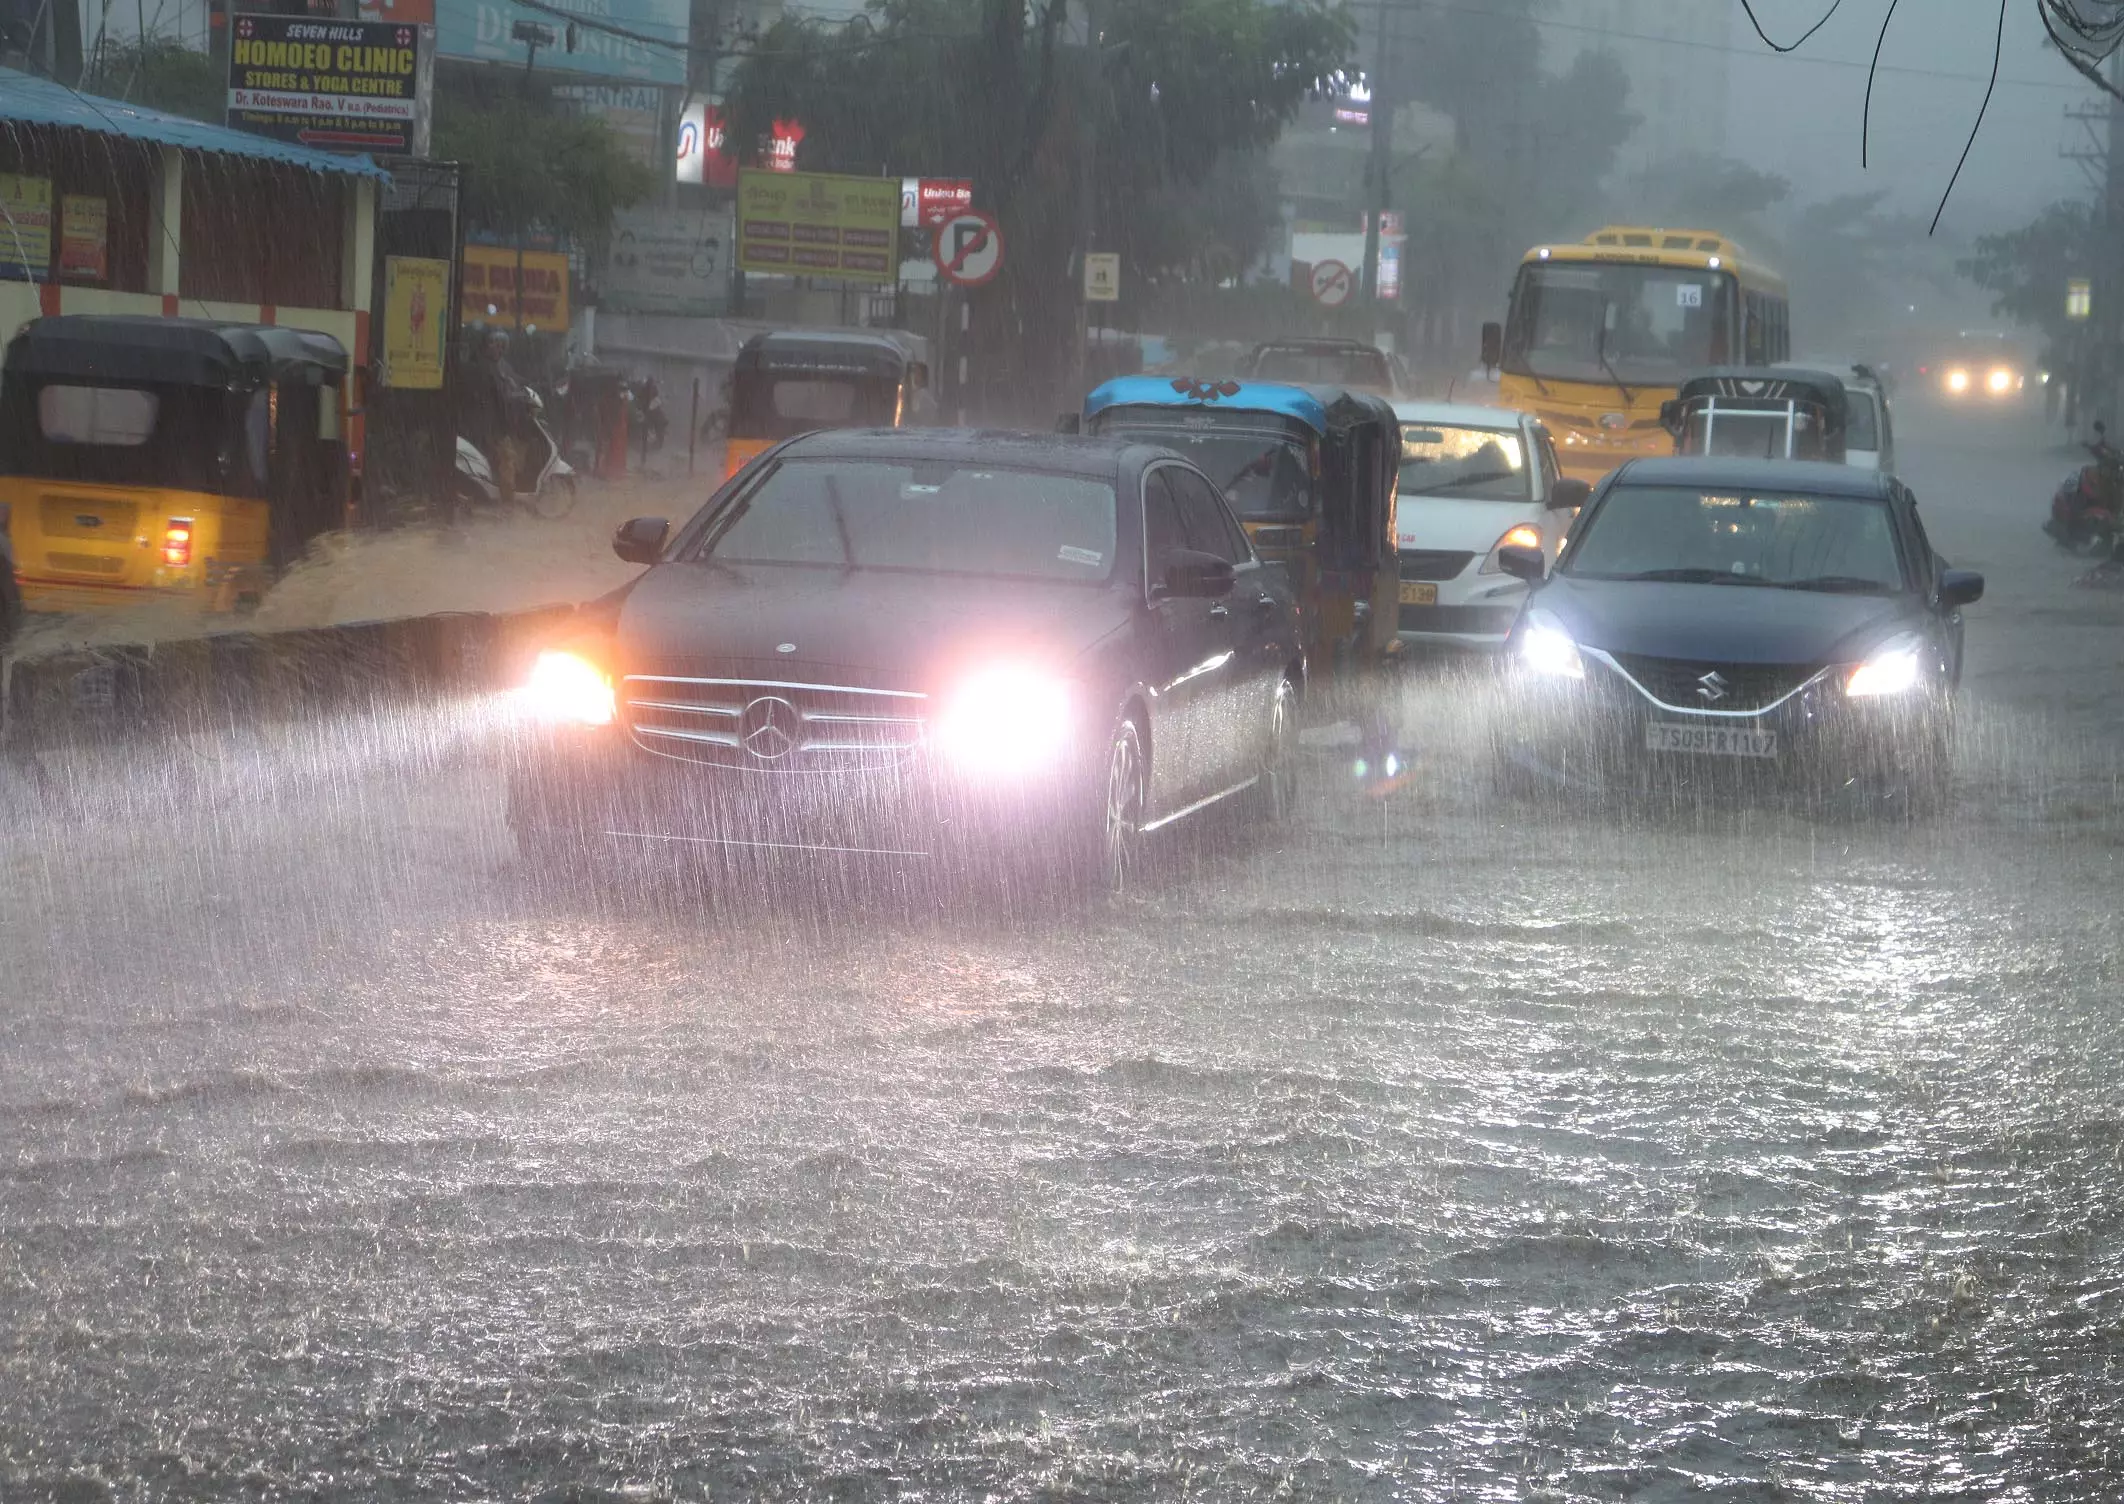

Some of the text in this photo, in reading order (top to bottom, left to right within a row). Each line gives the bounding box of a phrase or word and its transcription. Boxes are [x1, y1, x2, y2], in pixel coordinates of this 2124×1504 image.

[287, 24, 364, 41] SEVEN HILLS
[234, 39, 413, 74] HOMOEO CLINIC
[245, 71, 403, 96] STORES & YOGA CENTRE
[235, 91, 249, 106] Dr.
[252, 93, 308, 110] Koteswara
[1680, 292, 1698, 305] 16
